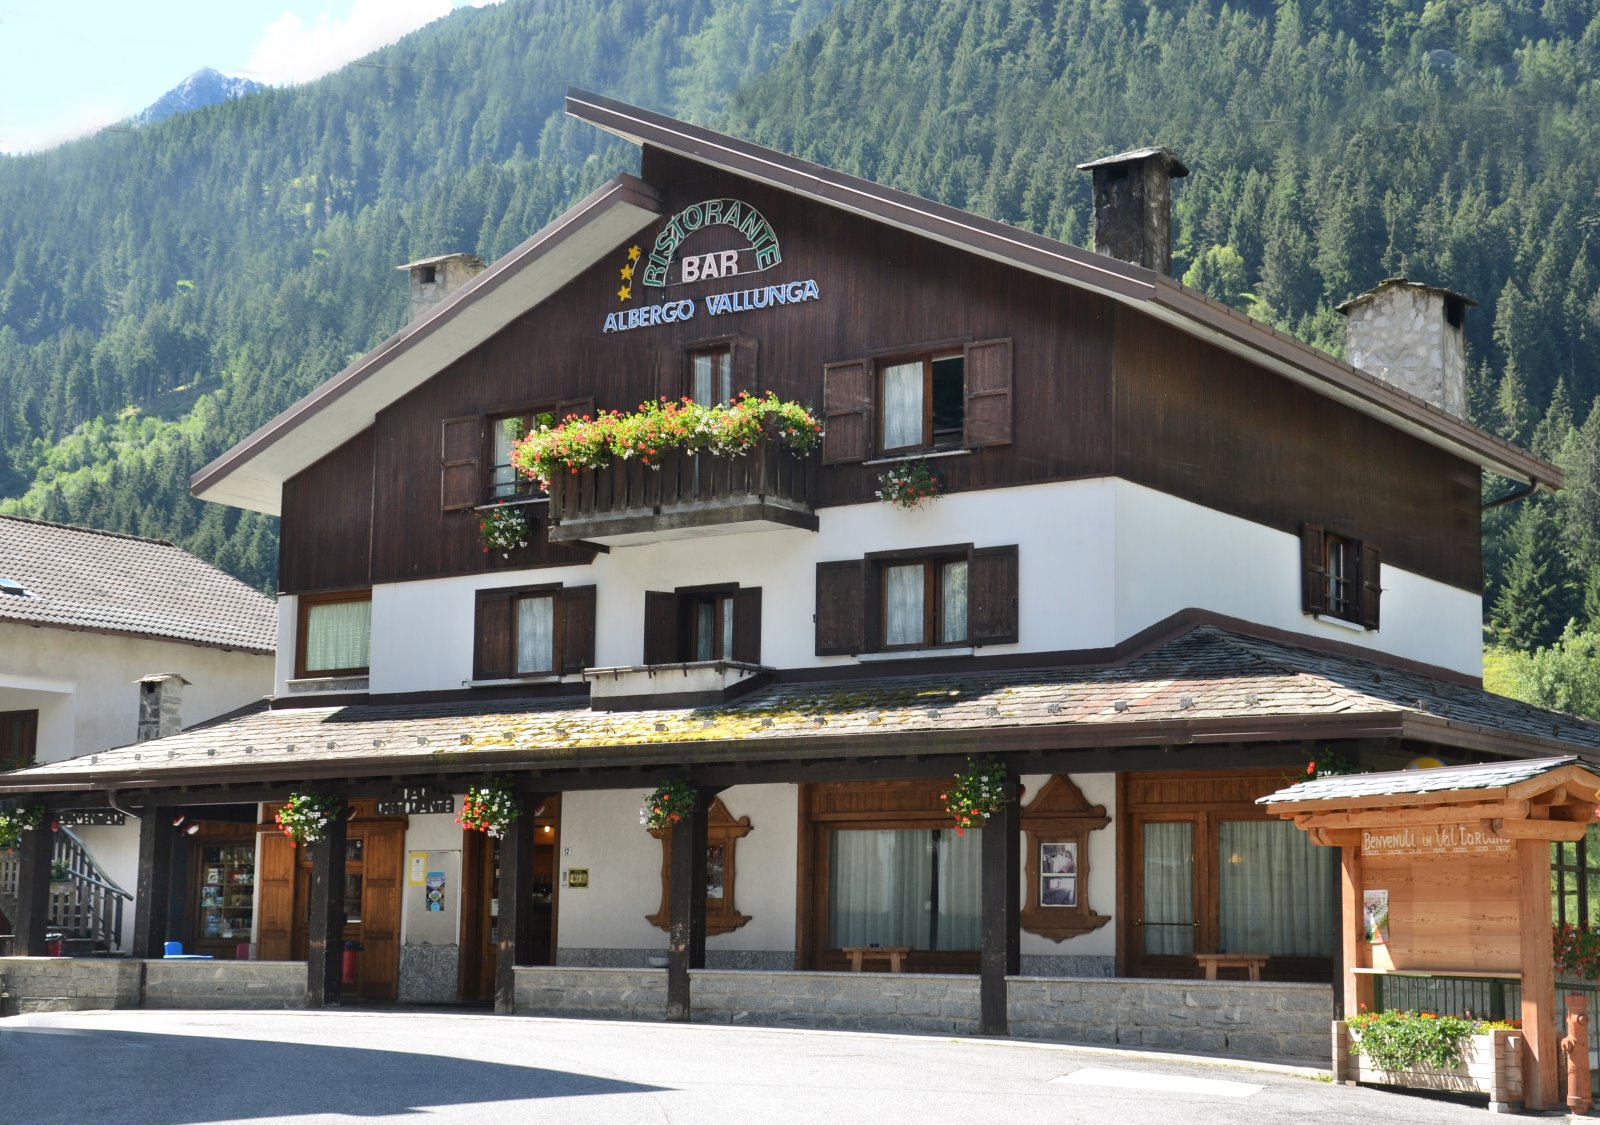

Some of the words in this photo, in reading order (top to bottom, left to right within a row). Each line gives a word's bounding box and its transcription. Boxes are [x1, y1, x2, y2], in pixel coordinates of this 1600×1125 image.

[643, 199, 782, 287] RISTORANTE
[682, 250, 738, 283] BAR
[603, 299, 695, 333] ALBERGO
[706, 279, 819, 316] VALLUNGA
